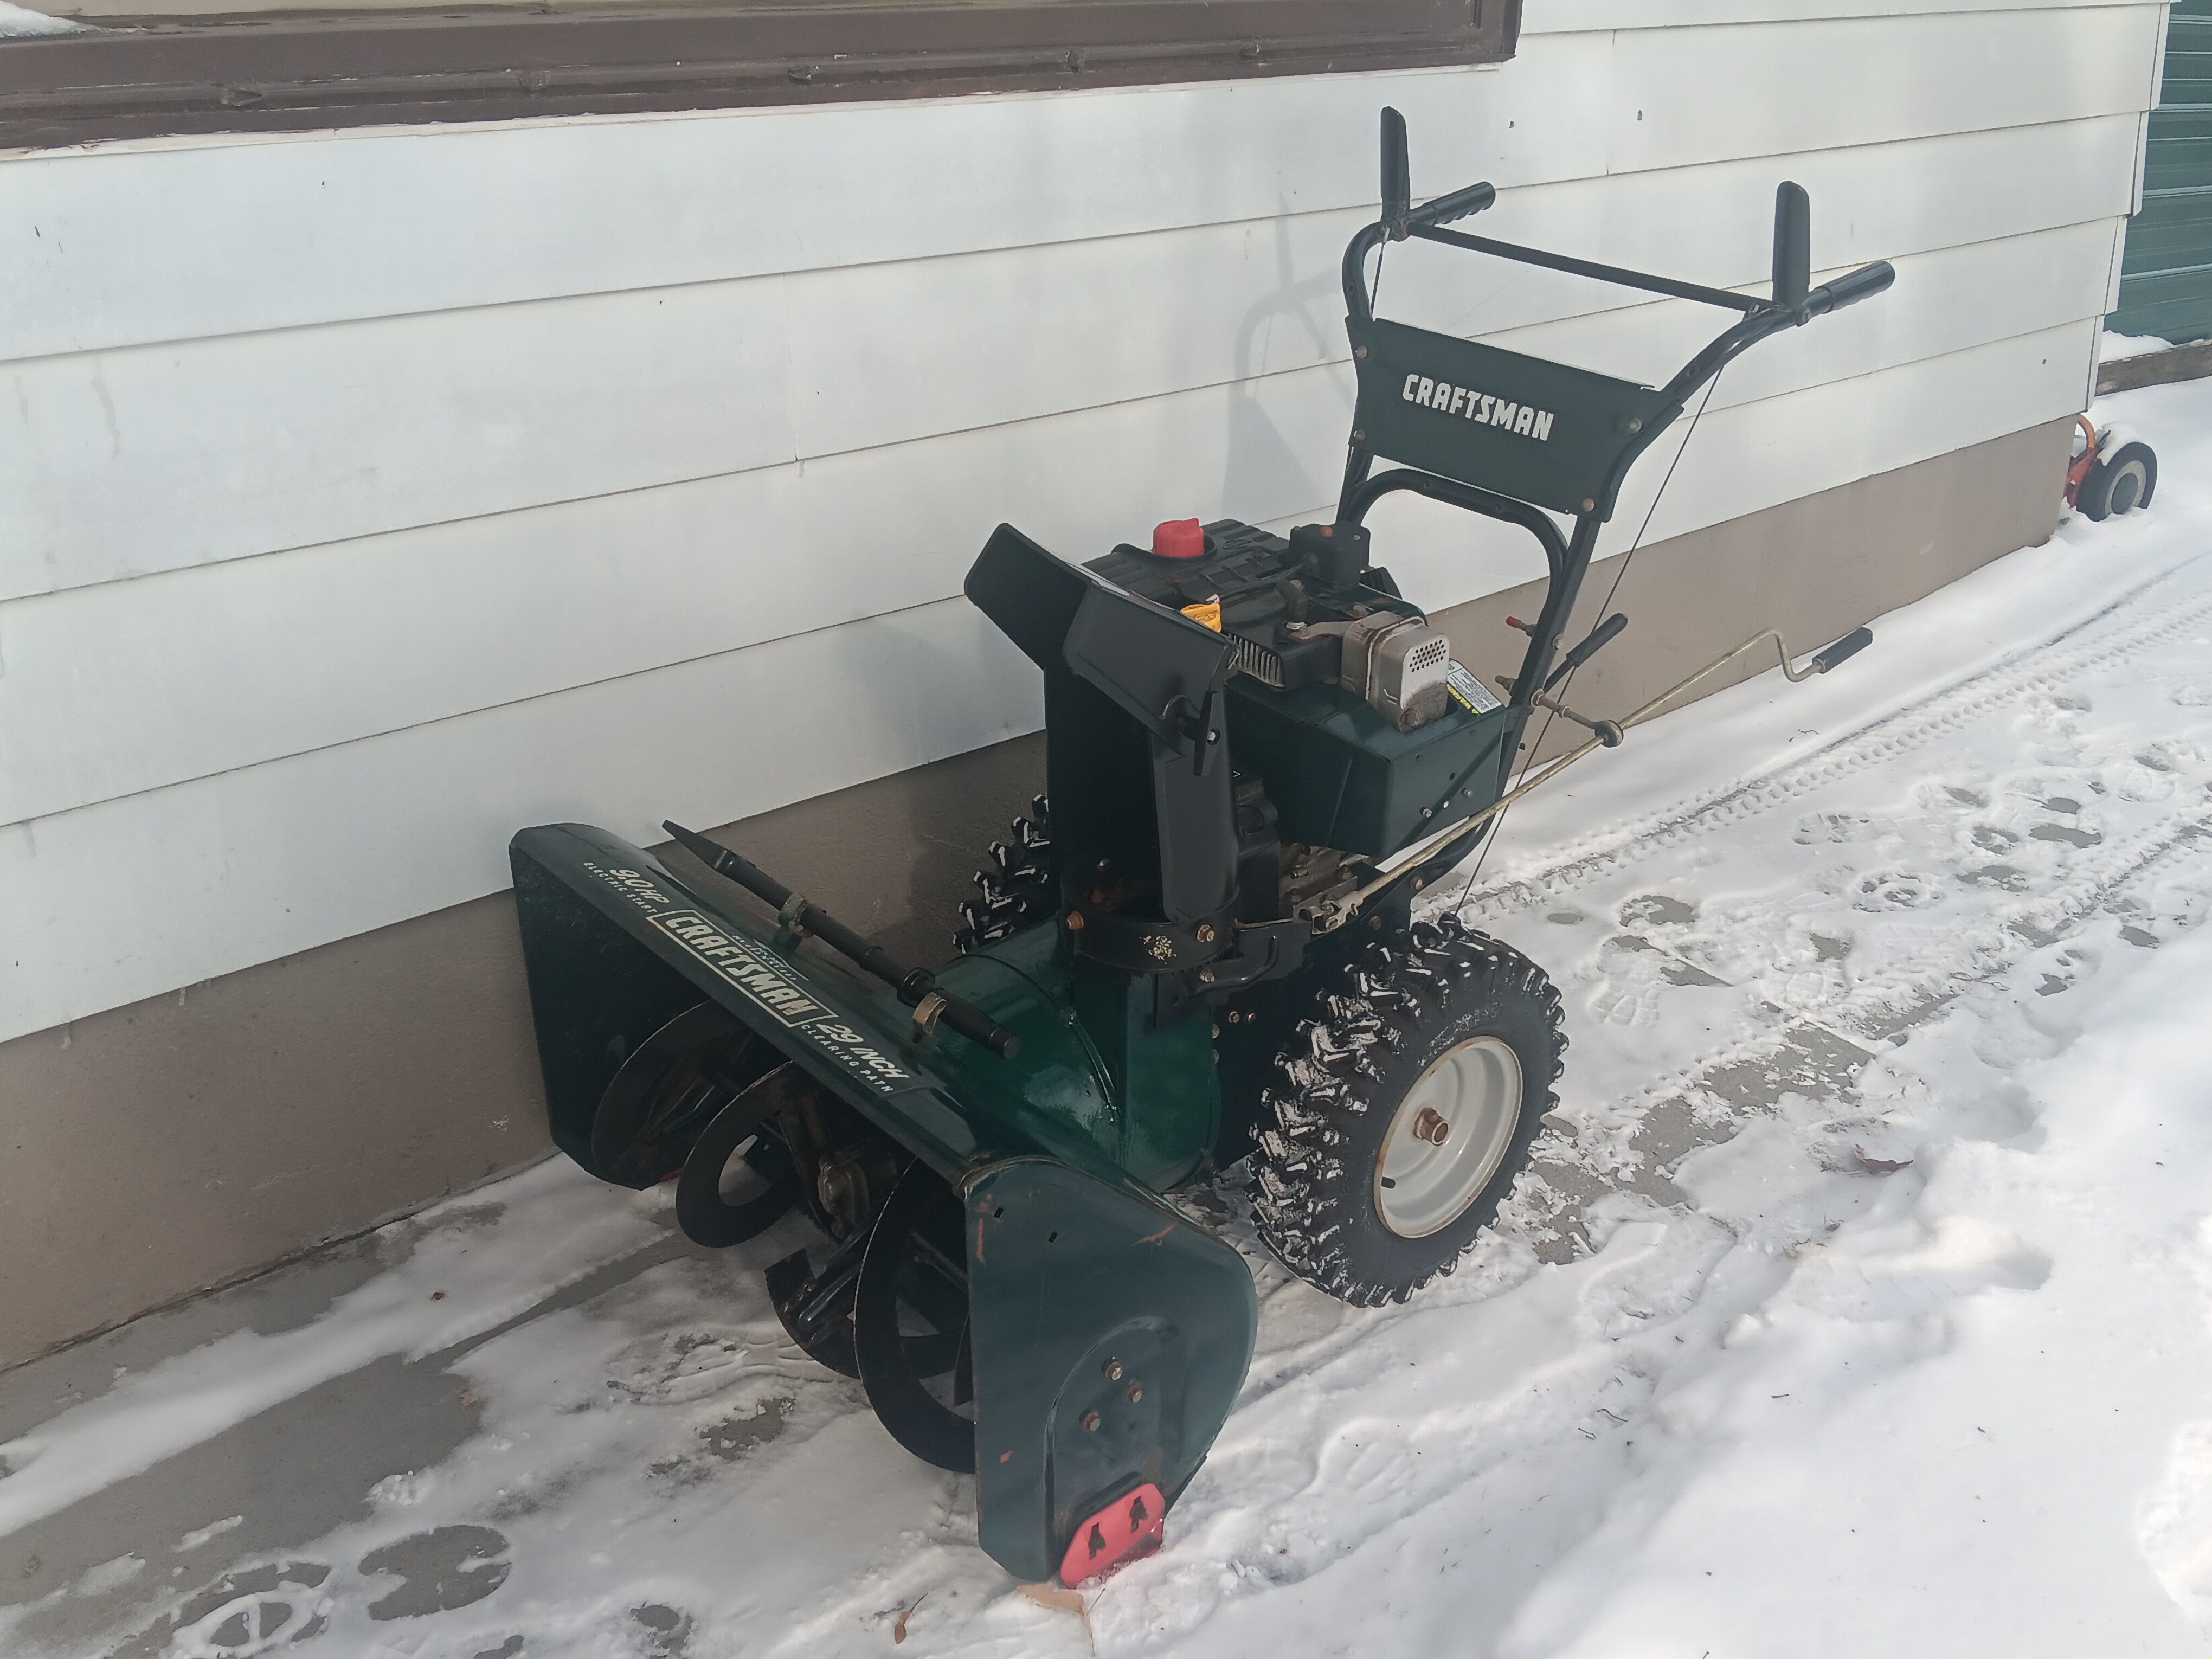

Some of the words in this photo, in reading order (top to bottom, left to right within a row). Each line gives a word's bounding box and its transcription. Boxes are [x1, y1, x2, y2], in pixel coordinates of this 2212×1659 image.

[1403, 374, 1554, 441] CRAFTSMAN
[1446, 684, 1471, 709] WARNIN
[583, 862, 627, 891] ELECTRIC
[627, 893, 658, 912] START
[665, 916, 819, 1016] CRAFTSMAN
[801, 1024, 859, 1066] CLEARING
[860, 1070, 893, 1092] PATH
[816, 1024, 864, 1043] 29
[850, 1047, 910, 1078] INCH
